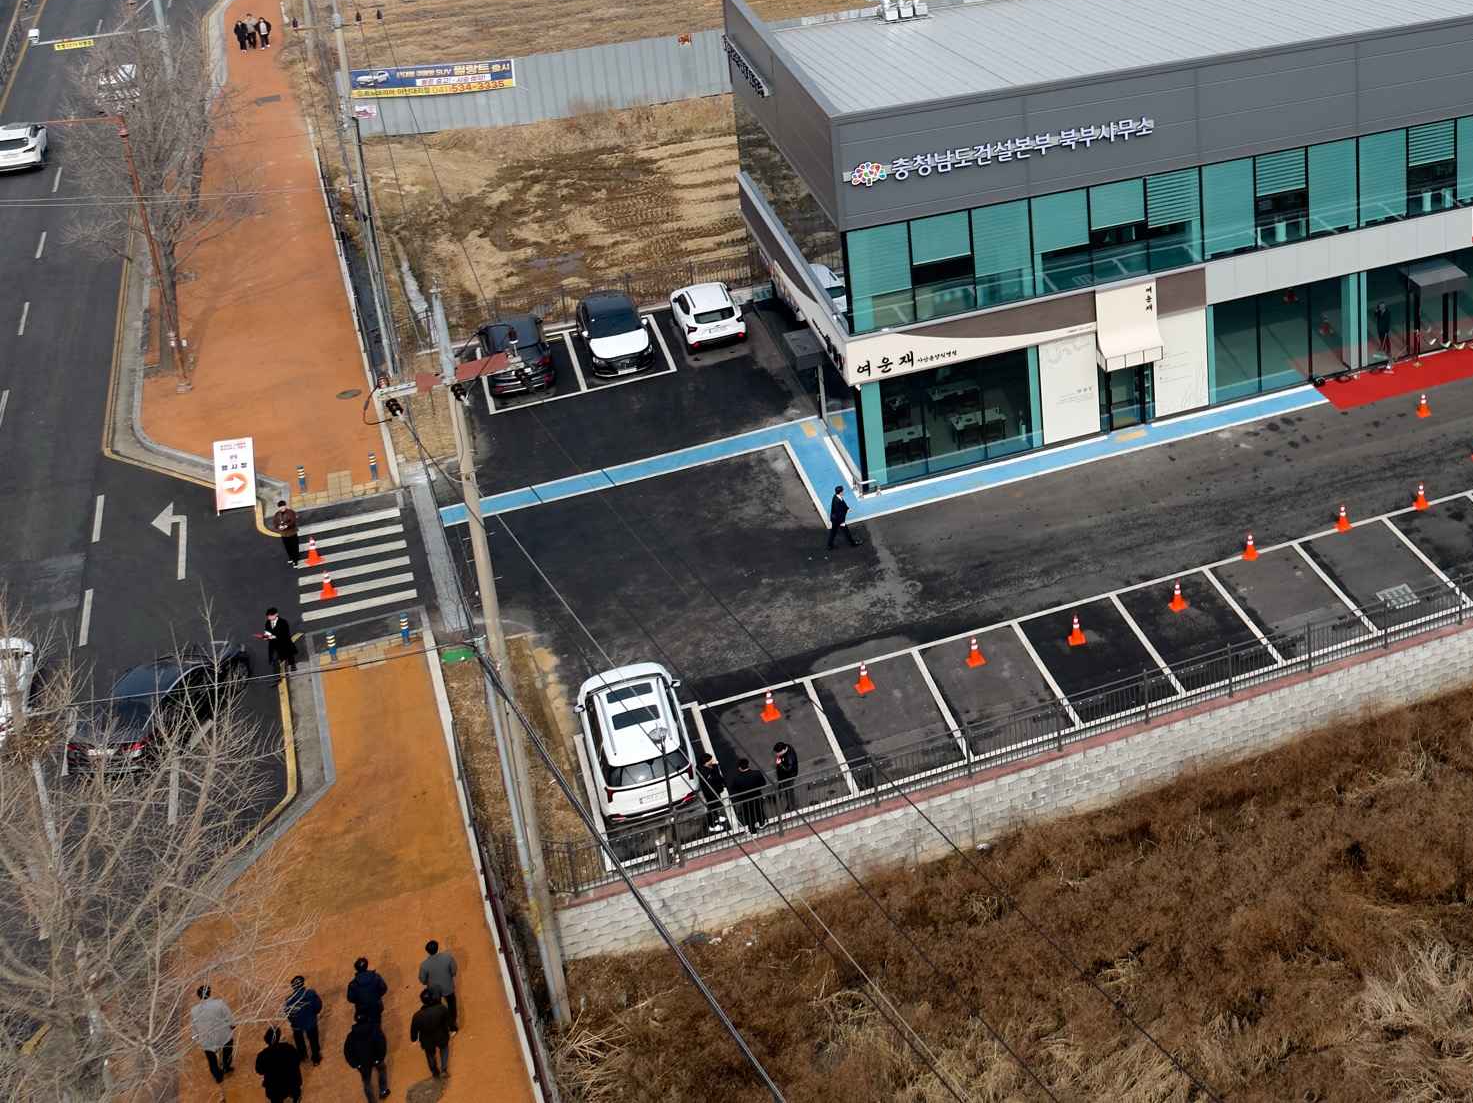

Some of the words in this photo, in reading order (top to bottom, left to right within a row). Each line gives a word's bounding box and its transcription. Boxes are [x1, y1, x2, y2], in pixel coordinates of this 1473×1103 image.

[436, 68, 451, 77] SUV
[892, 133, 1053, 180] 충청남도건설본부
[1058, 117, 1153, 149] 북부사무소
